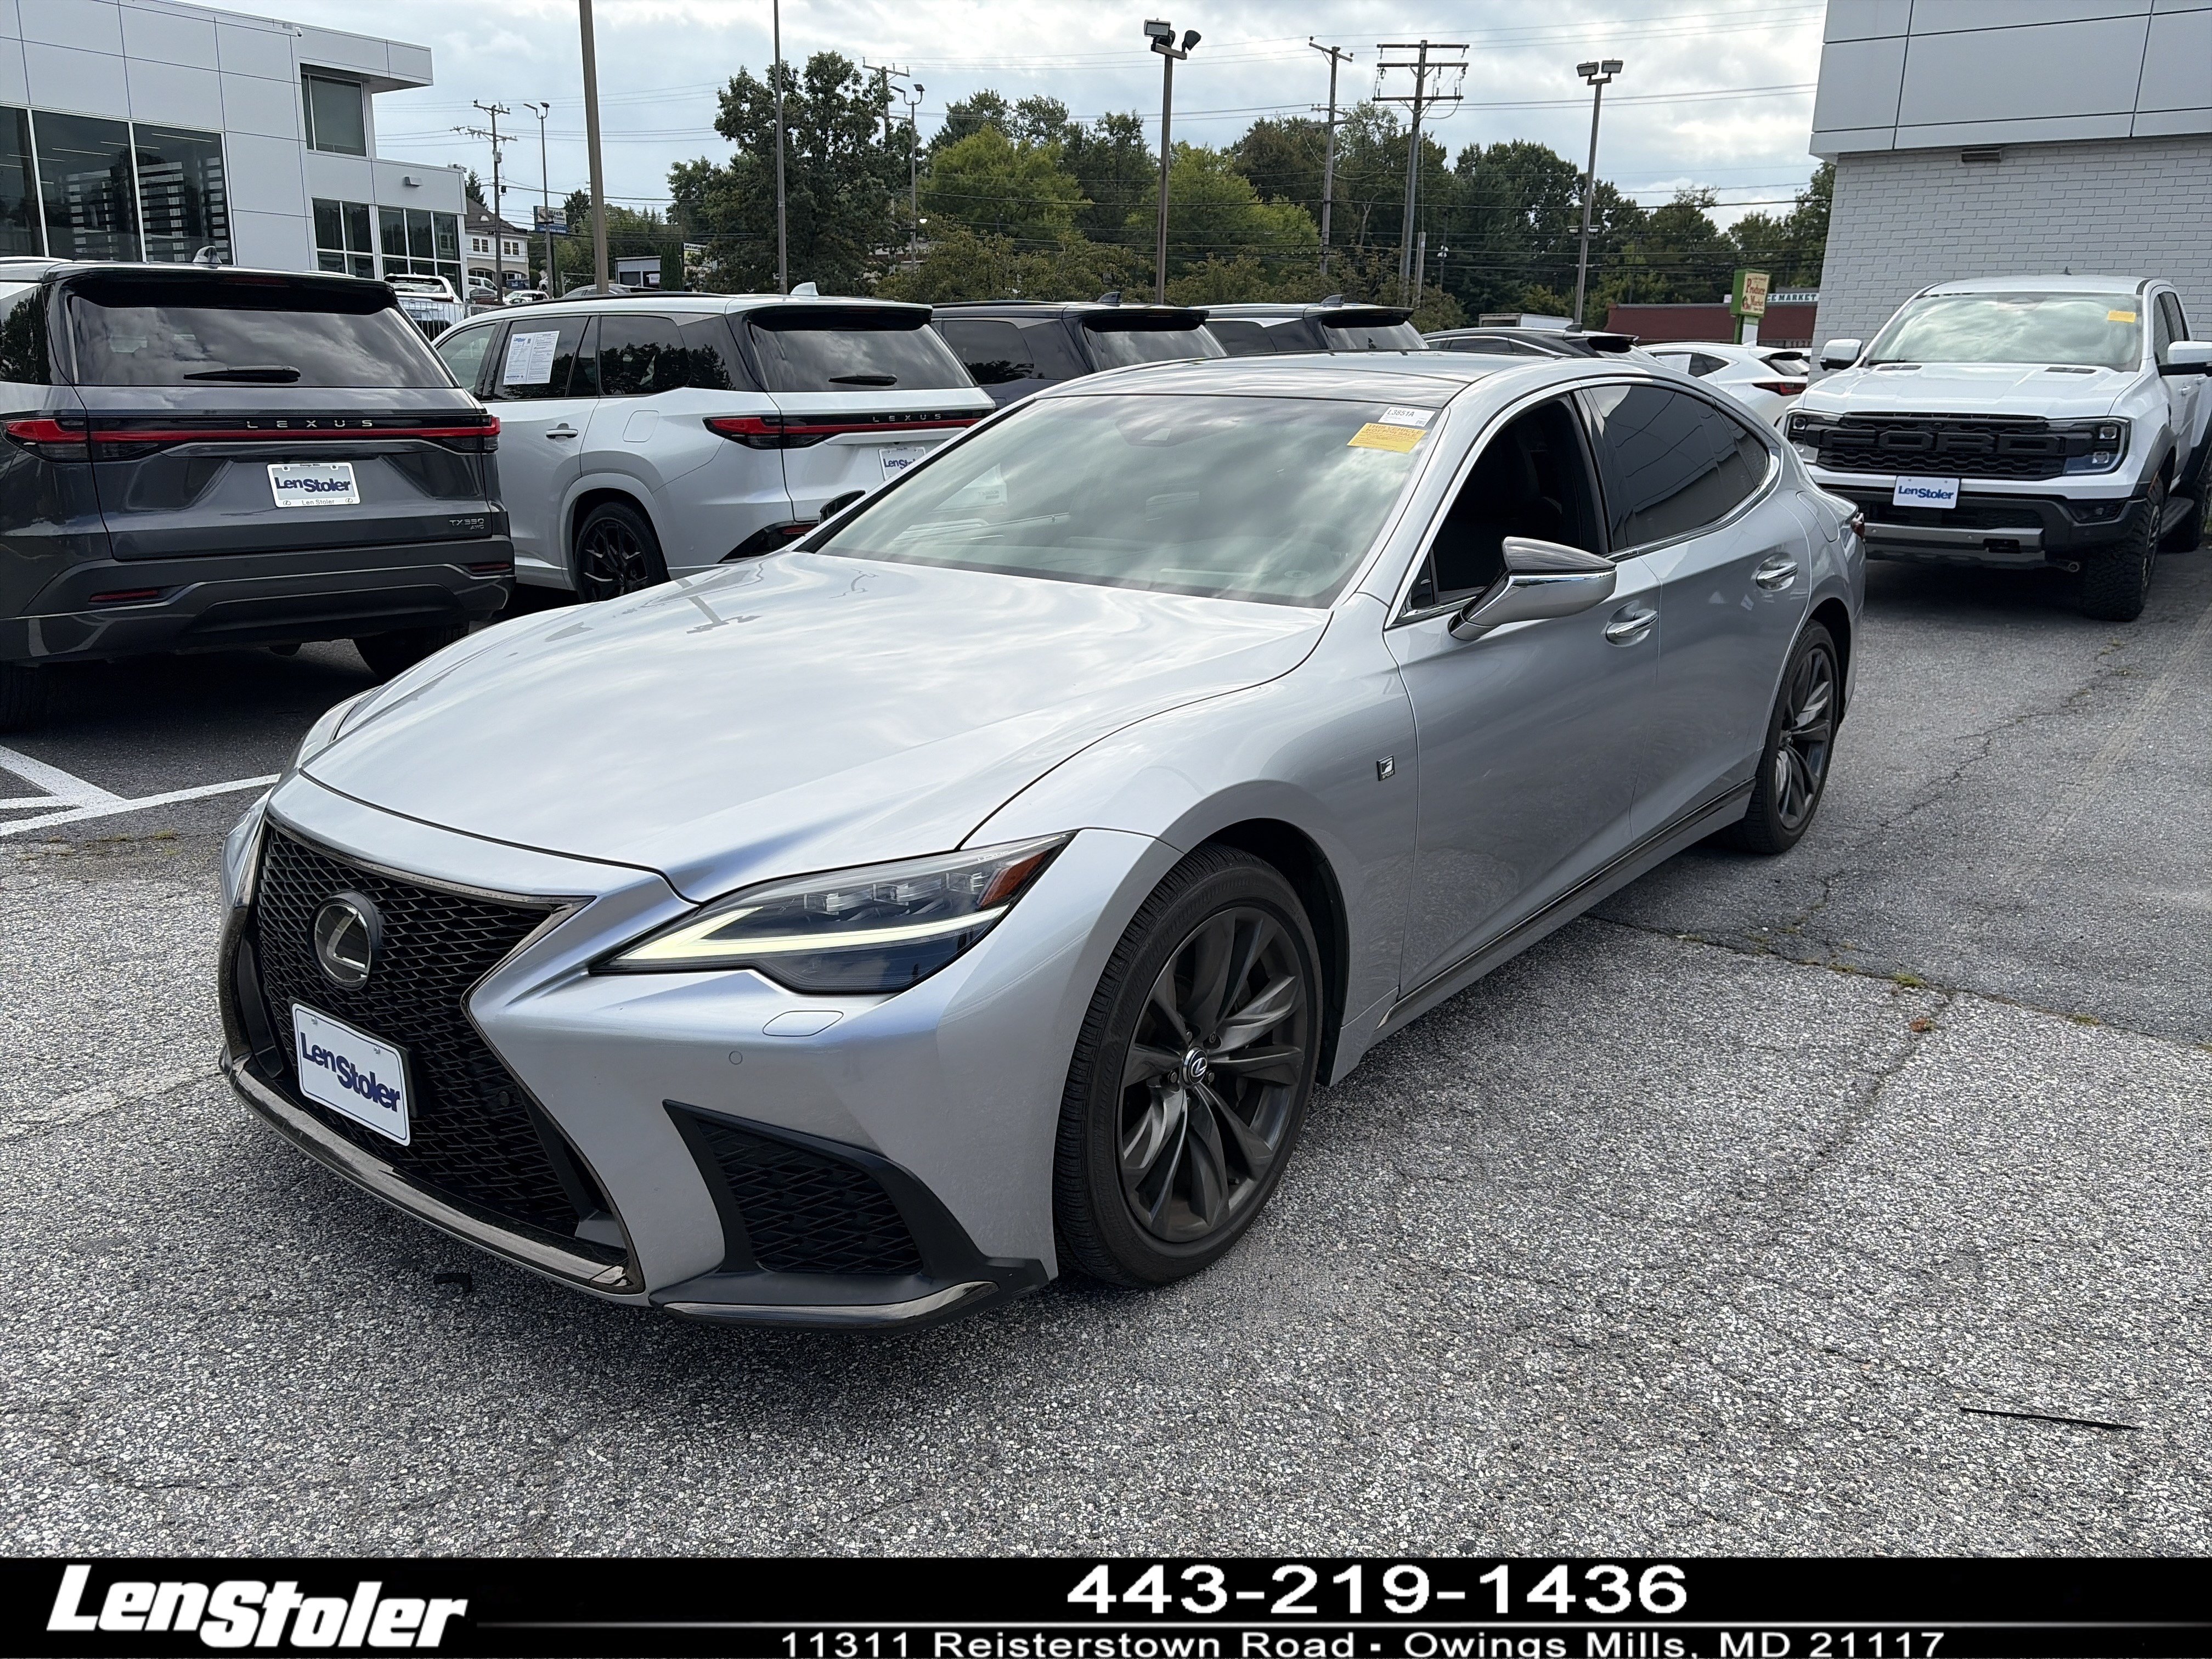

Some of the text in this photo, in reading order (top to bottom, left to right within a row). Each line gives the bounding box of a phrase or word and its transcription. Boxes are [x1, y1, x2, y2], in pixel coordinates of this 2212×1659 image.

[873, 414, 941, 422] LEXUS
[246, 420, 373, 428] LEXUS
[1387, 426, 1423, 435] VEHICLE
[1820, 428, 2061, 456] FORD
